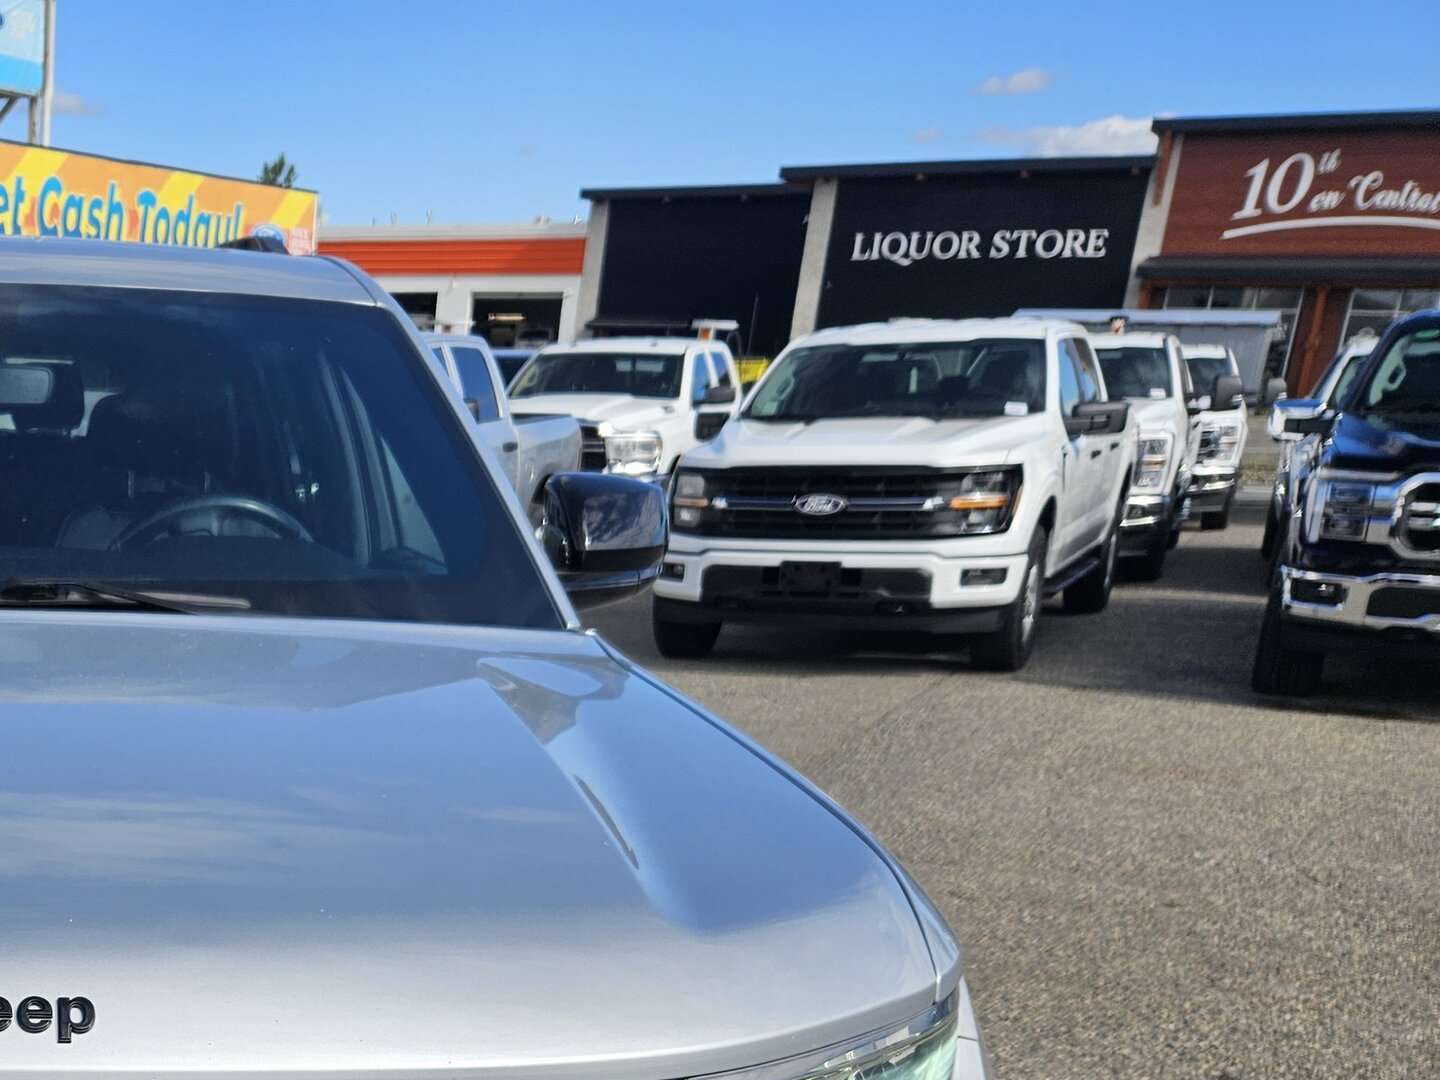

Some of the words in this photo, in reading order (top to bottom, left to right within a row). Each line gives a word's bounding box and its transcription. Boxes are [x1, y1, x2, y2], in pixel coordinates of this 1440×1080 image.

[38, 176, 125, 240] Cash
[849, 230, 982, 267] LIQUOR
[988, 228, 1110, 260] STORE
